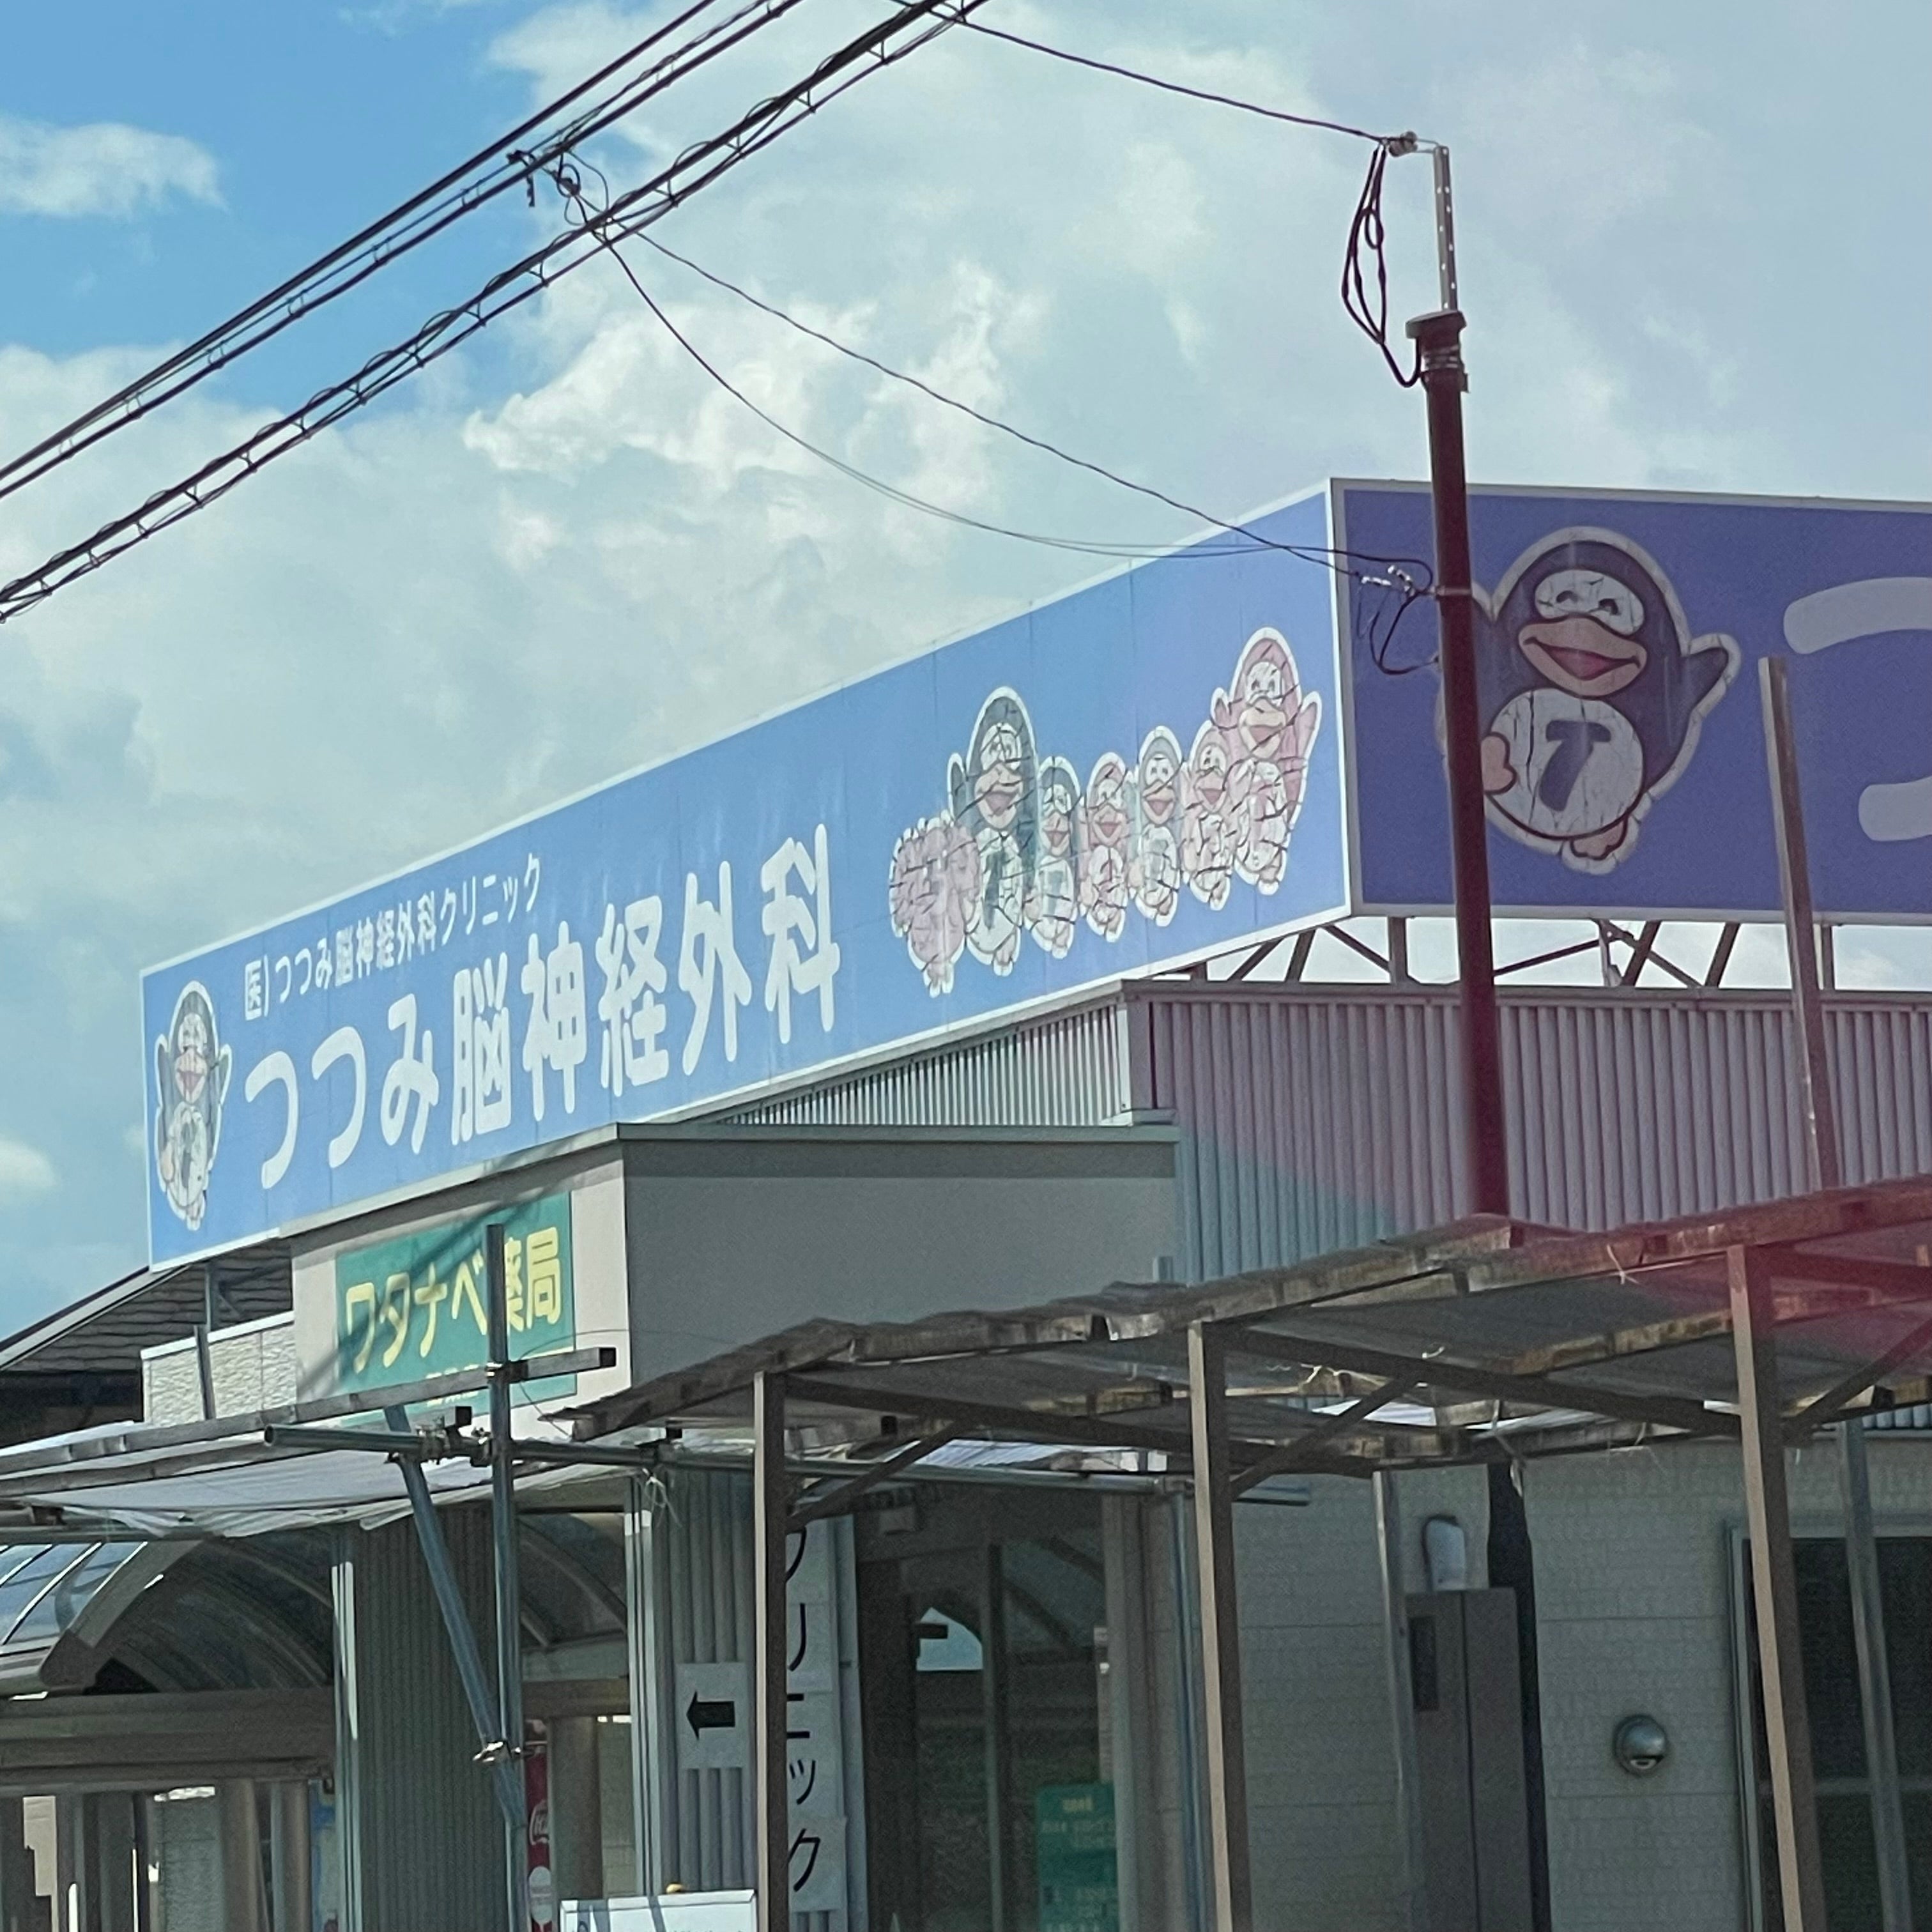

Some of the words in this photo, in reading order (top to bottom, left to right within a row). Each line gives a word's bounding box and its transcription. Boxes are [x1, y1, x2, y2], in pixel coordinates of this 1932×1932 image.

[245, 823, 841, 1190] つつみ脳神経外科
